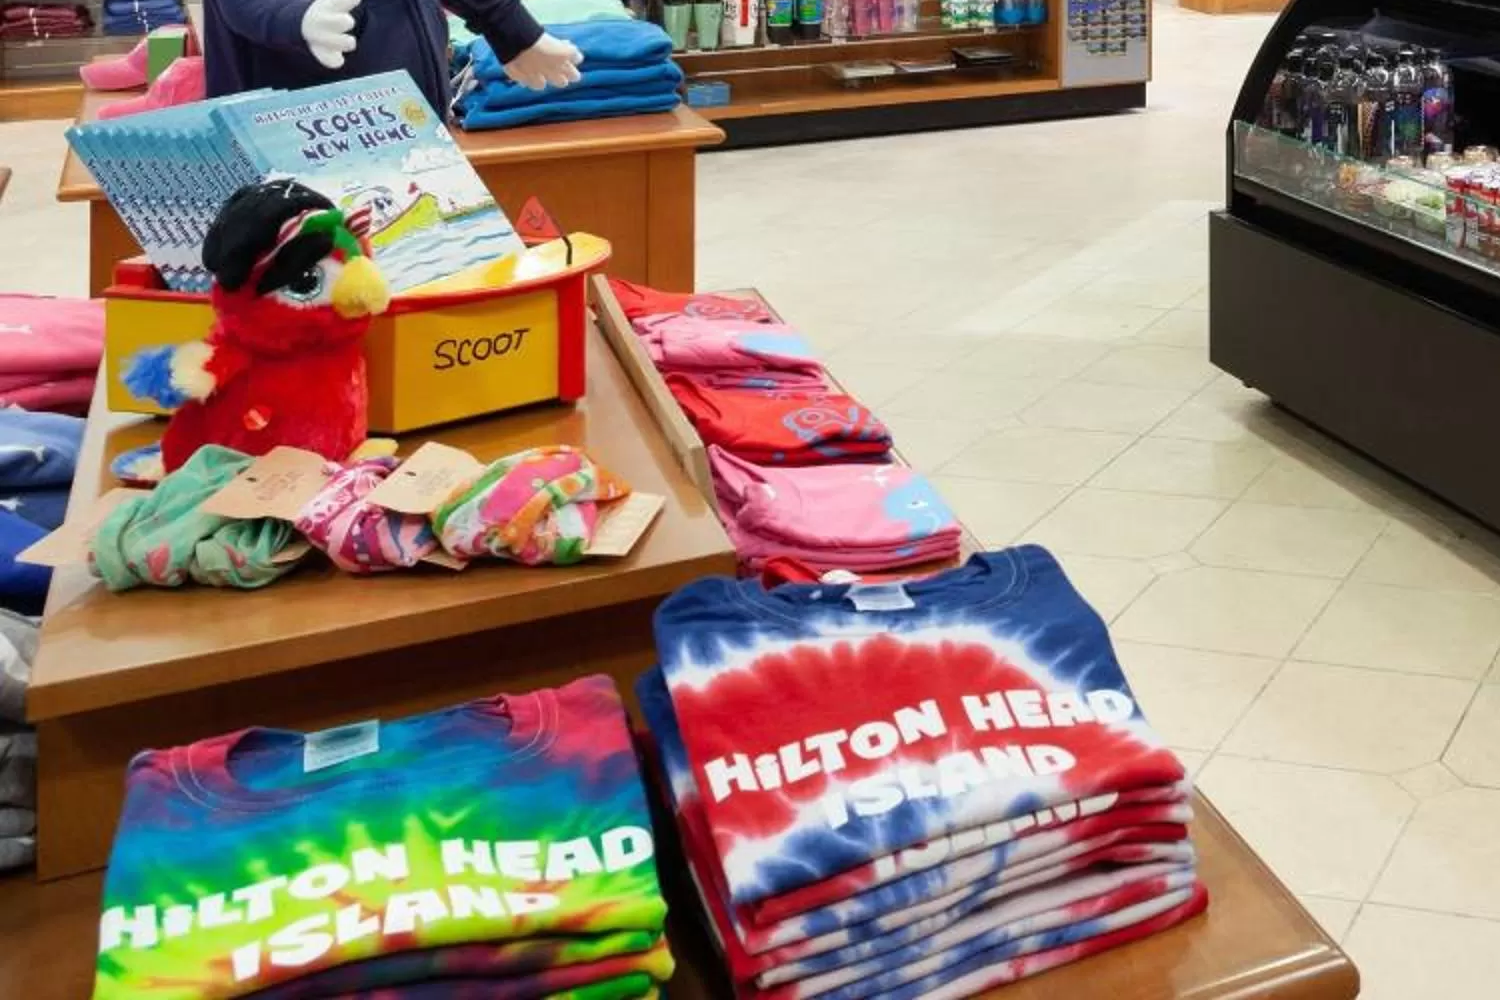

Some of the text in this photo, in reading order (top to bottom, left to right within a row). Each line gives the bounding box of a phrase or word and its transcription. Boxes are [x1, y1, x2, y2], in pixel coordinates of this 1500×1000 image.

[434, 328, 530, 370] SCOOT
[960, 689, 1134, 737] HEAD
[825, 744, 1077, 830] ISLAND
[440, 825, 654, 881] HEAD
[231, 885, 561, 980] ISLAND
